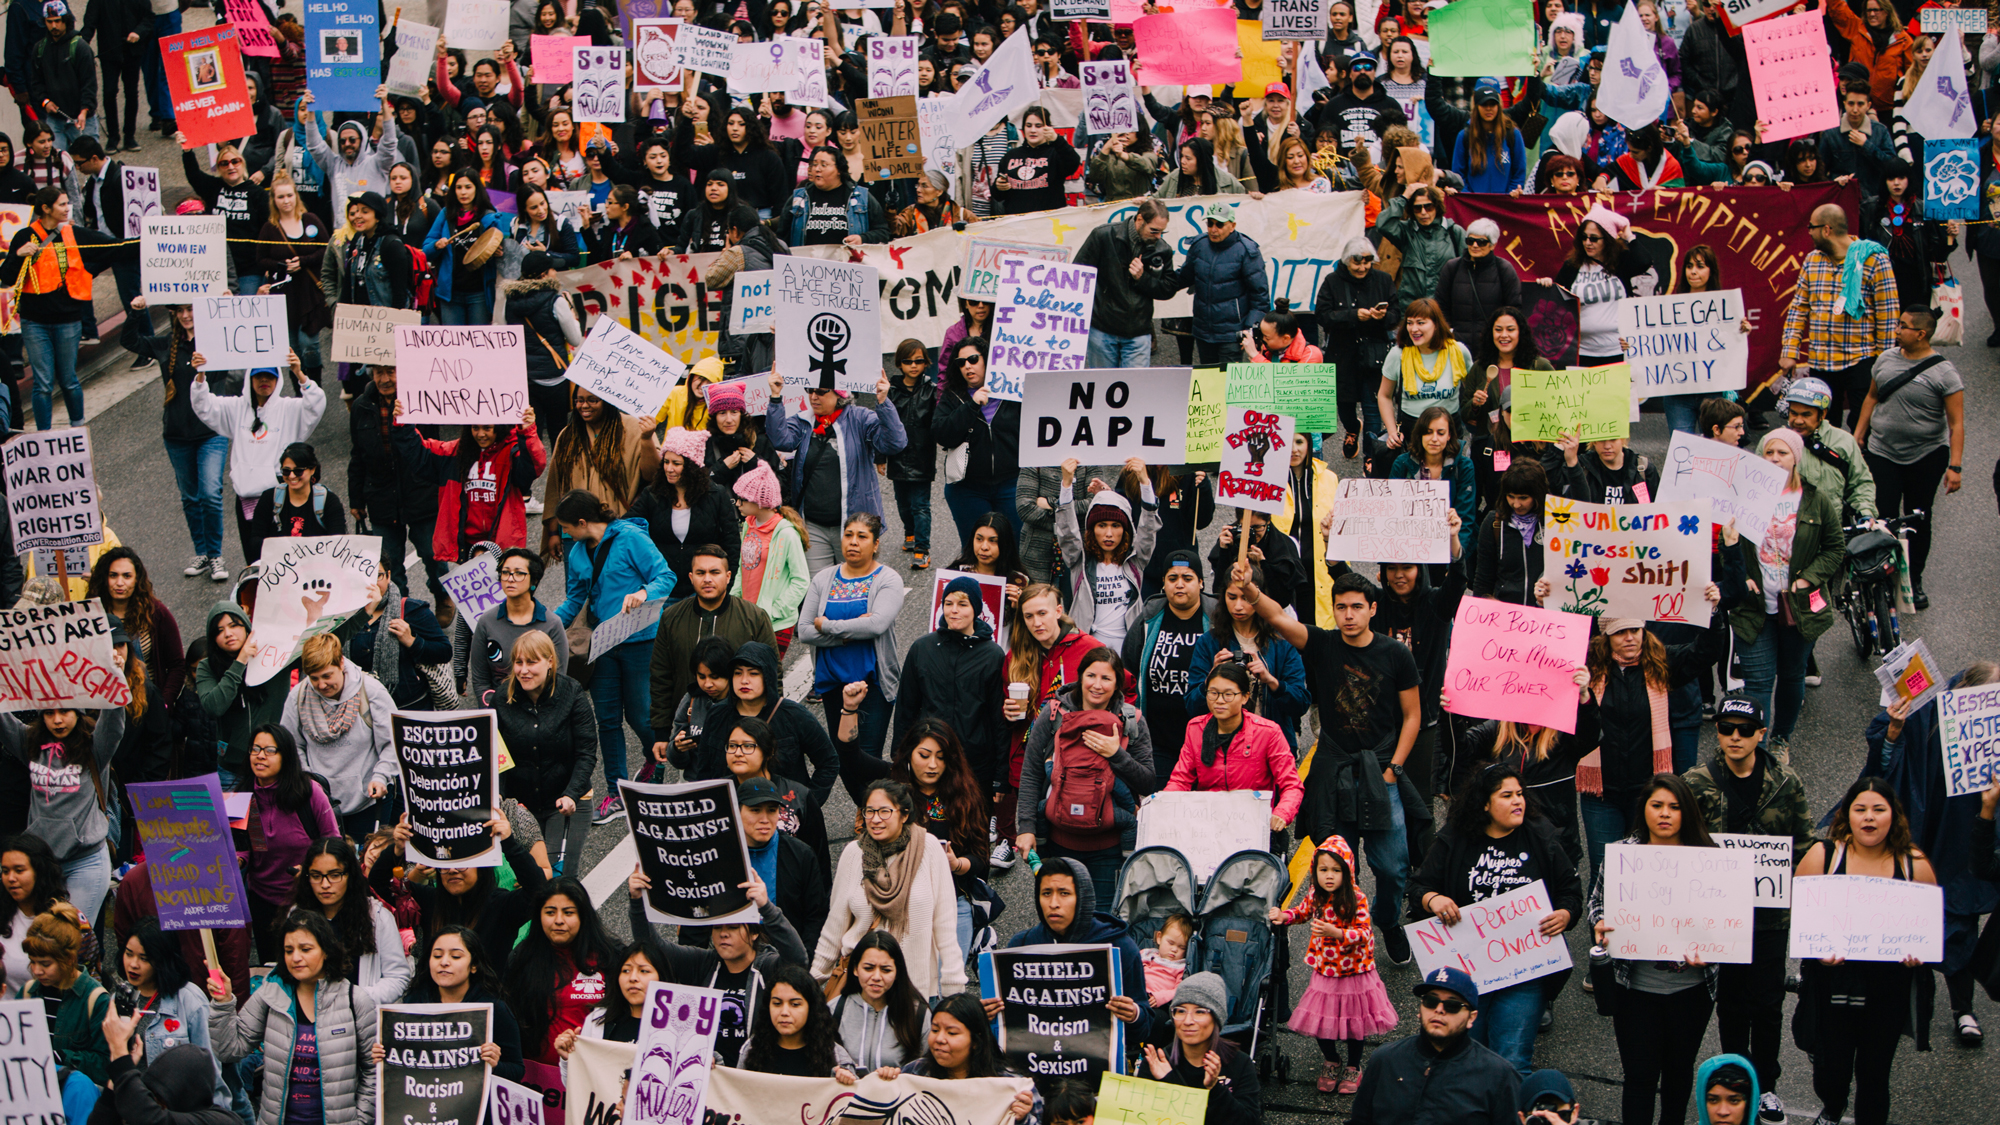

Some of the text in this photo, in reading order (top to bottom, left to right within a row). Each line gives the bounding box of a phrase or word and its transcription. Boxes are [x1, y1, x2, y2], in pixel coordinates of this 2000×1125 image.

[1271, 0, 1319, 12] TRANS
[1923, 10, 1986, 20] STRONGER
[1273, 16, 1317, 28] LIVES!
[1746, 20, 1818, 43] WOMEN'S
[1923, 21, 1986, 31] TOGTHER
[168, 41, 184, 52] AW
[190, 34, 214, 47] HEIL
[1756, 45, 1816, 66] RIGHTS
[310, 68, 378, 78] HAS GOT 2 GO
[1764, 80, 1823, 101] EQUAL
[180, 95, 216, 112] NEVER
[207, 102, 240, 118] AGAIN
[862, 120, 916, 142] WATER
[872, 145, 903, 159] LIFE
[1926, 139, 1976, 148] WE WANT
[212, 209, 250, 221] MATTER
[1924, 208, 1978, 219] LIBERATION
[148, 225, 184, 235] WELL
[158, 243, 207, 254] WOMEN
[146, 258, 194, 268] SELDOM
[185, 270, 221, 281] MAKE
[149, 282, 209, 293] HISTORY
[741, 279, 771, 298] not
[784, 276, 861, 297] PLACE IS IN
[206, 297, 274, 320] DEPORT
[778, 289, 871, 312] THE STRUGGLE
[1013, 288, 1084, 316] believe
[362, 308, 388, 320] NO
[996, 307, 1088, 334] I STILL
[1634, 298, 1734, 327] ILLEGAL
[336, 318, 381, 332] HUMAN
[367, 335, 376, 344] IS
[403, 329, 517, 350] UNDOCUMENTED
[996, 326, 1070, 350] have to
[1626, 328, 1726, 358] BROWN &
[992, 346, 1085, 370] PROTEST
[428, 357, 473, 384] AND
[1276, 365, 1297, 375] LOVE
[1313, 365, 1334, 374] LOVE
[1519, 369, 1610, 390] I AM NOT
[1646, 359, 1716, 386] NASTY
[1069, 380, 1130, 410] NO
[1191, 380, 1202, 402] A
[1227, 383, 1271, 400] AMERICA
[407, 387, 524, 418] UNAFRAID!
[1534, 400, 1546, 409] AN
[1244, 410, 1281, 430] OUR
[1518, 410, 1588, 423] I AM AN
[1037, 416, 1166, 448] DAPL
[1225, 426, 1285, 451] EXISTENCE
[6, 435, 85, 466] END THE
[10, 462, 85, 490] WAR ON
[1244, 461, 1264, 476] IS
[1219, 470, 1285, 502] RESISTANCE
[1340, 480, 1436, 498] WE ARE ALL
[12, 489, 91, 515] WOMEN'S
[1334, 497, 1446, 517] OPPRESSED WHEN
[18, 512, 92, 538] RIGHTS!
[1583, 507, 1670, 532] unlearn
[1550, 537, 1661, 559] oppressive
[1622, 560, 1689, 592] shit!
[64, 616, 110, 643] ARE
[1465, 605, 1566, 640] OUR BODIES
[1153, 643, 1179, 657] FUL
[1482, 639, 1575, 673] OUR MINDS
[1149, 655, 1167, 669] IN
[54, 650, 131, 706] RIGHTS
[1455, 668, 1554, 700] OUR POWER
[1722, 700, 1754, 714] Resiste
[402, 725, 478, 746] ESCUDO
[402, 746, 482, 768] CONTRA
[29, 760, 82, 777] WONDER
[30, 774, 80, 787] WOMAN
[408, 768, 481, 791] Detención y
[132, 792, 173, 812] I am
[409, 787, 480, 813] Deportación
[637, 798, 716, 819] SHIELD
[436, 815, 445, 824] de
[636, 817, 730, 842] AGAINST
[412, 819, 483, 843] Inmigrantes
[1725, 838, 1789, 852] A Womxn
[657, 846, 719, 867] Racism
[1476, 853, 1522, 872] Mujeres
[1619, 851, 1740, 878] No Soy Santa
[688, 870, 696, 879] &
[155, 886, 236, 907] NOTHING
[665, 879, 726, 899] Sexism
[1614, 908, 1744, 934] Soy lo que se me
[1799, 932, 1929, 946] Fuck your border.
[1620, 940, 1736, 962] da la gana!
[1809, 944, 1904, 956] Fuck your ban
[1012, 962, 1094, 980] SHIELD
[1006, 986, 1106, 1007] AGAINST
[394, 1021, 473, 1042] SHIELD
[1028, 1013, 1090, 1036] Racism
[1053, 1040, 1062, 1051] &
[386, 1046, 482, 1069] AGAINST
[1028, 1052, 1088, 1075] Sexism
[405, 1075, 464, 1098] Racism
[429, 1102, 437, 1113] &
[1110, 1076, 1192, 1119] THERE
